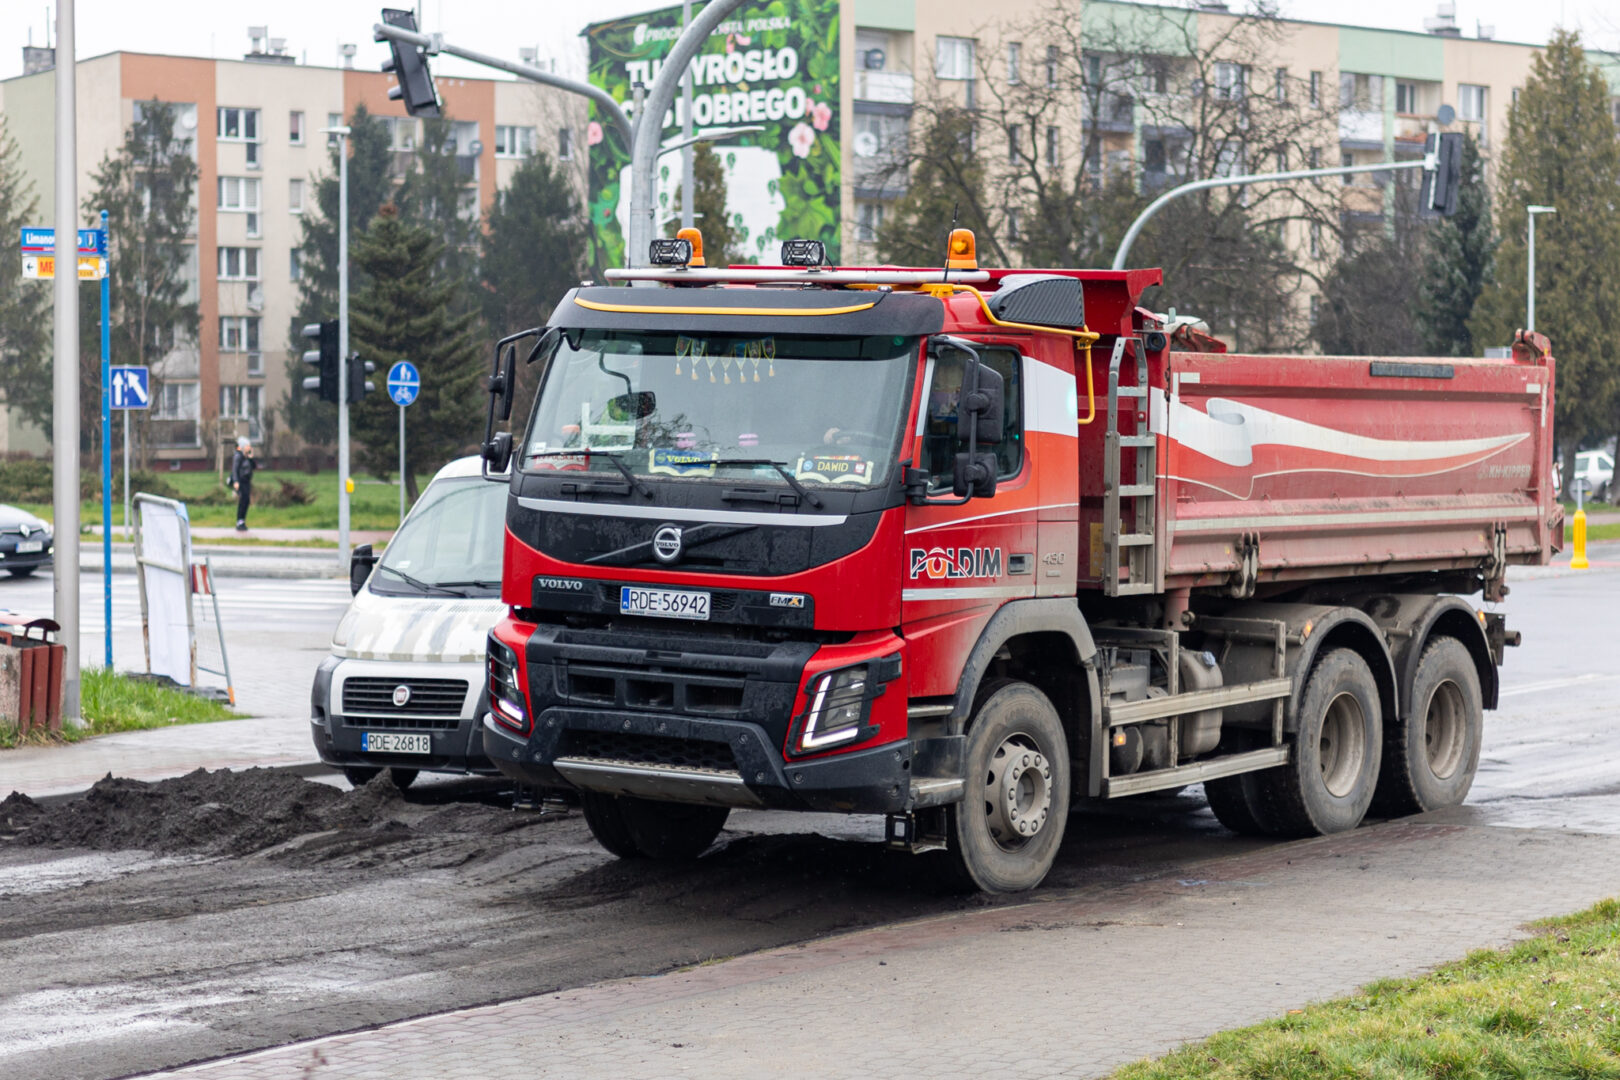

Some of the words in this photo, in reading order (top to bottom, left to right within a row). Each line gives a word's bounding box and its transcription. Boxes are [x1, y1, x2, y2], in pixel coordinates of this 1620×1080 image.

[747, 17, 791, 32] POLSKA
[677, 47, 798, 87] YROSŁO
[817, 461, 848, 472] DAWID
[910, 548, 1002, 579] POLDIM
[538, 579, 583, 591] VOLVO
[630, 591, 658, 611] RDE
[662, 593, 707, 615] 56942
[771, 596, 802, 607] FMX
[368, 734, 390, 750] RDE
[393, 735, 429, 752] 26818
